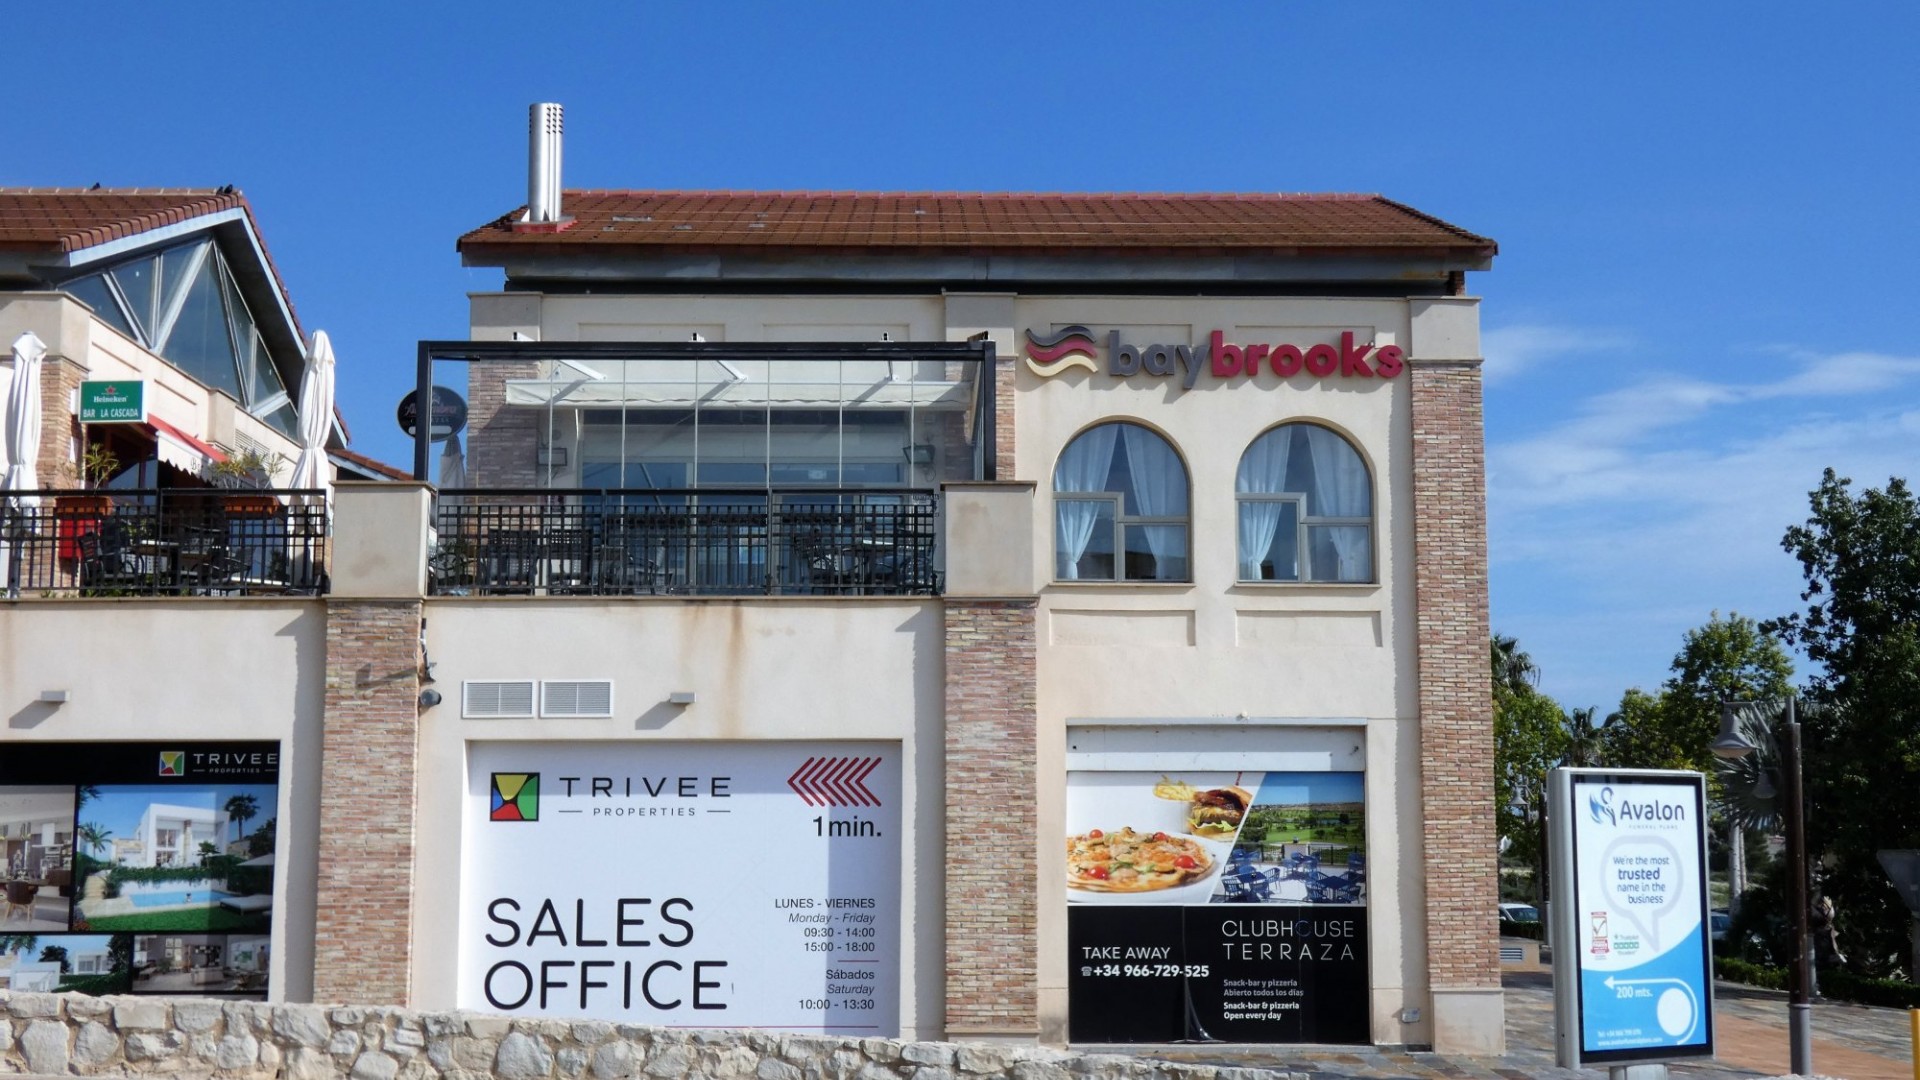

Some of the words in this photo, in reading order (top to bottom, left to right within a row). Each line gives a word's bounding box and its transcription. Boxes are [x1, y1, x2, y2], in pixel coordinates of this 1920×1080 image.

[1108, 330, 1404, 390] baybrooks
[93, 395, 127, 403] Heineken
[83, 408, 96, 418] BAR
[100, 408, 109, 418] LA
[110, 408, 139, 418] CASCADA
[193, 753, 278, 765] TRIVEE
[559, 777, 731, 798] TRIVEE
[593, 808, 695, 816] PROPERTIES
[1620, 799, 1685, 821] Avalon
[1613, 856, 1634, 865] We're
[1635, 856, 1648, 865] the
[1650, 856, 1670, 865] most
[1618, 867, 1660, 880] trusted
[1617, 884, 1640, 892] name
[1642, 882, 1650, 892] in
[1652, 882, 1666, 892] the
[775, 898, 814, 908] LUNES
[825, 898, 876, 908] VIERNES
[1628, 894, 1664, 904] business
[485, 897, 694, 948] SALES
[788, 913, 832, 925] Monday
[842, 913, 875, 925] Friday
[804, 928, 834, 937] 09:30
[846, 928, 875, 937] 14:00
[804, 942, 834, 952] 15:00
[846, 942, 875, 952] 18:00
[1082, 946, 1121, 959] TAKE
[1125, 946, 1171, 959] AWAY
[1222, 943, 1354, 960] TERRAZA
[826, 969, 874, 980] Sábados
[1094, 964, 1120, 977] +34
[1124, 964, 1210, 978] 966-729-525
[484, 960, 728, 1010] OFFICE
[1224, 979, 1260, 987] Snack-bar
[1261, 980, 1266, 988] y
[826, 984, 874, 996] Saturday
[1616, 986, 1634, 998] 200
[1635, 988, 1653, 998] mts.
[799, 1000, 830, 1010] 10:00
[843, 1000, 874, 1010] 13:30
[1224, 1002, 1260, 1010] Snack-bar
[1262, 1002, 1268, 1010] &
[1224, 1012, 1244, 1020] Open
[1268, 1012, 1282, 1020] day
